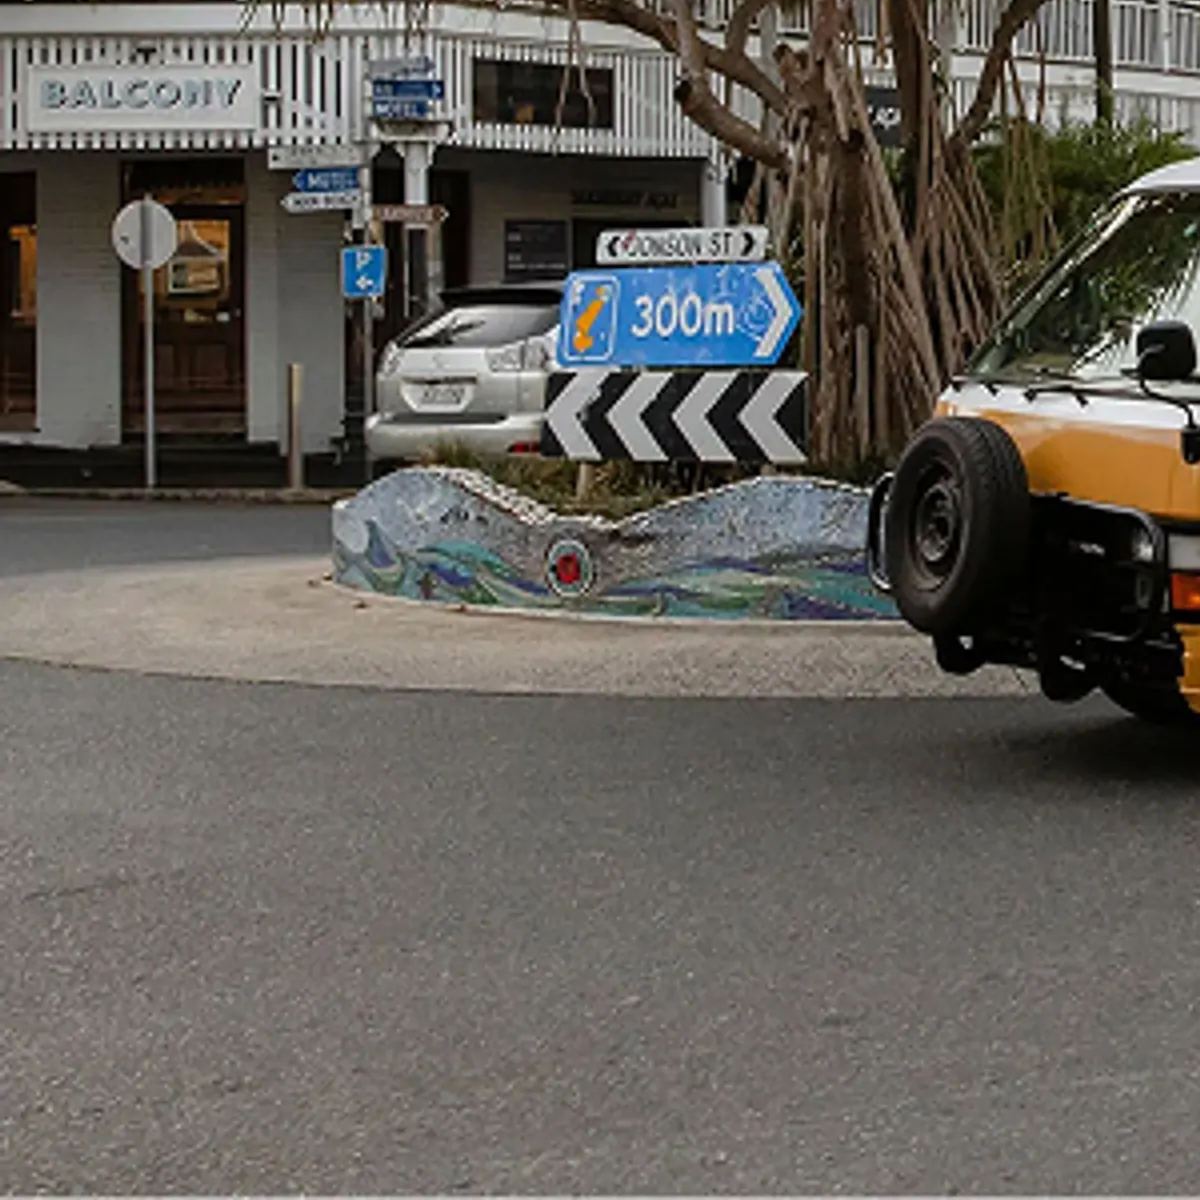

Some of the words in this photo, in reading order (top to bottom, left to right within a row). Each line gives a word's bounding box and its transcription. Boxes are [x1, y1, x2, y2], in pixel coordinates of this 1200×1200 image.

[41, 79, 242, 109] BALCONY
[709, 232, 732, 256] ST
[631, 294, 735, 338] 300m
